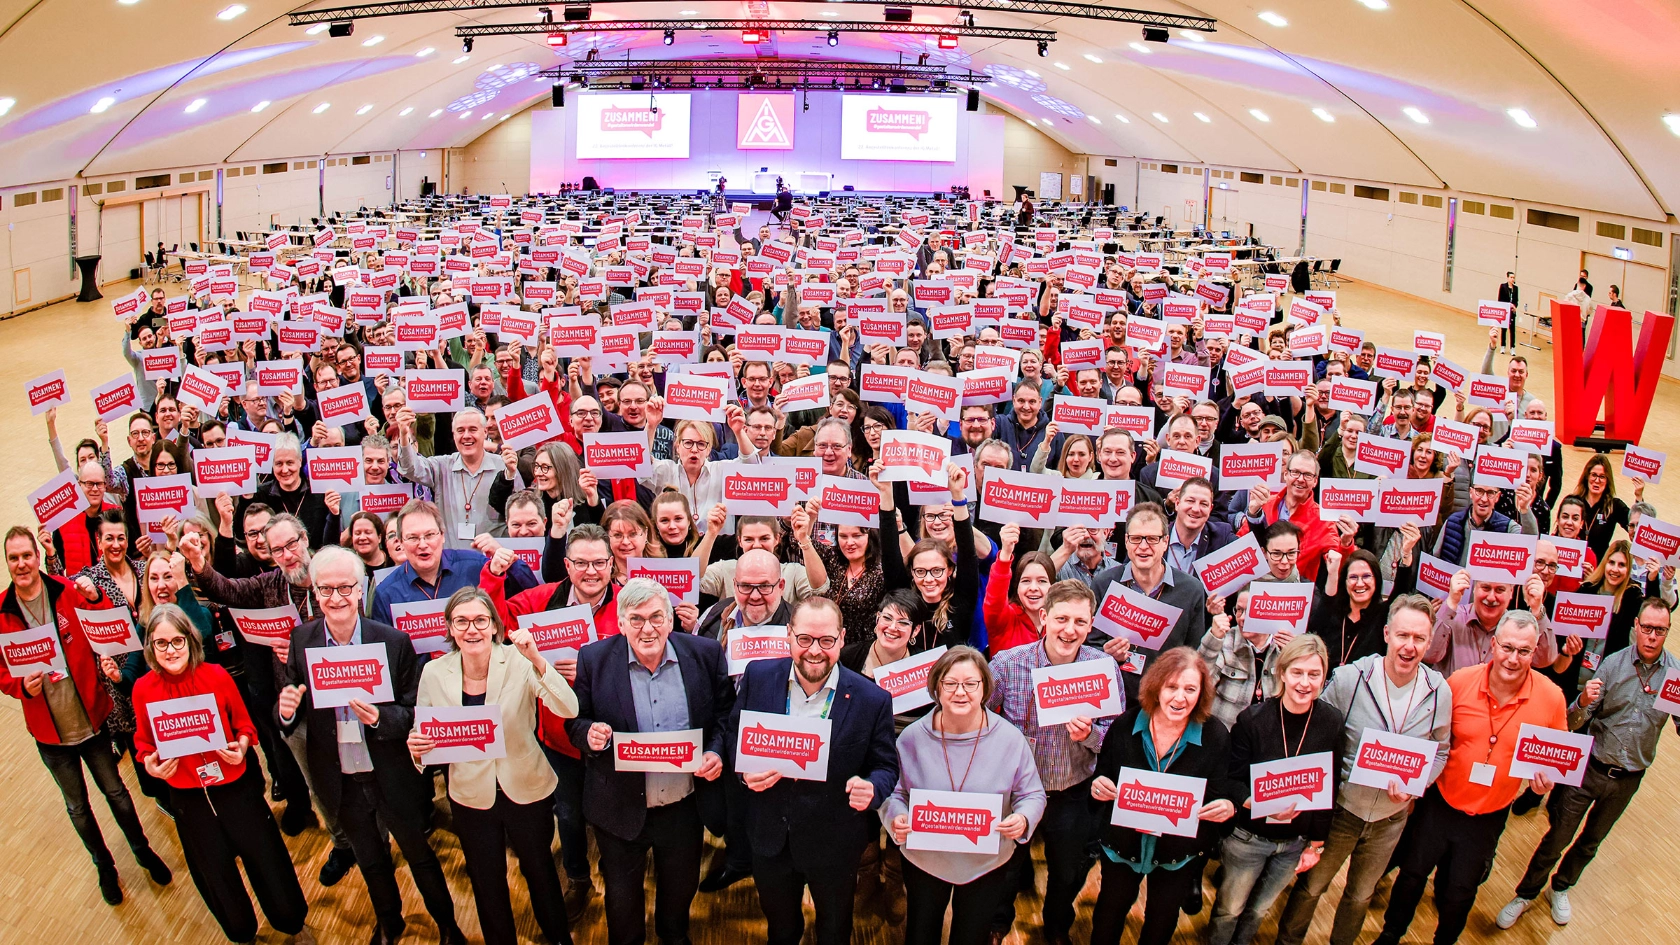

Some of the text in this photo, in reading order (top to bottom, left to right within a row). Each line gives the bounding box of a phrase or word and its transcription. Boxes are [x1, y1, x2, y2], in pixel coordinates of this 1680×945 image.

[869, 113, 925, 125] ZUSAMMEN!
[314, 312, 340, 325] ZUSAMMEN!
[615, 311, 649, 321] ZUSAMMEN!
[935, 314, 969, 325] ZUSAMMEN!
[1071, 308, 1100, 319] ZUSAMMEN!
[502, 319, 532, 330] ZUSAMMEN!
[1236, 315, 1263, 326] ZUSAMMEN!
[400, 327, 434, 335] ZUSAMMEN!
[862, 323, 898, 331] ZUSAMMEN!
[1003, 328, 1032, 336] ZUSAMMEN!
[1129, 325, 1158, 337] ZUSAMMEN!
[281, 331, 313, 339] ZUSAMMEN!
[552, 329, 592, 339] ZUSAMMEN!
[740, 336, 778, 344] ZUSAMMEN!
[1333, 334, 1358, 344] ZUSAMMEN!
[601, 337, 631, 347] SAMMEN!
[787, 340, 821, 349] ZUSAMMEN!
[1064, 349, 1098, 359] ZUSAMMEN!
[146, 357, 174, 366] ZUSAMMEN!
[978, 356, 1012, 366] ZUSAMMEN!
[1379, 356, 1410, 368] ZUSAMMEN!
[261, 371, 295, 380] ZUSAMMEN!
[1167, 373, 1202, 385] ZUSAMMEN!
[1268, 372, 1305, 380] ZUSAMMEN!
[1436, 365, 1462, 382] ZUSAMMEN!
[185, 376, 216, 396] ZUSAMMEN!
[865, 376, 905, 386] ZUSAMMEN!
[30, 381, 61, 400] ZUSAMMEN!
[410, 383, 455, 393] ZUSAMMEN!
[670, 387, 717, 400] ZUSAMMEN!
[910, 383, 952, 400] ZUSAMMEN!
[1334, 387, 1368, 399] ZUSAMMEN!
[1473, 383, 1504, 394] ZUSAMMEN!
[96, 386, 131, 408] ZUSAMMEN!
[323, 395, 360, 411] ZUSAMMEN!
[1057, 407, 1097, 418] ZUSAMMEN!
[501, 408, 546, 432] ZUSAMMEN!
[1110, 416, 1146, 425] ZUSAMMEN!
[1437, 428, 1470, 443] ZUSAMMEN!
[1514, 429, 1546, 439] ZUSAMMEN!
[589, 447, 639, 458] ZUSAMMEN!
[885, 446, 940, 462] ZUSAMMEN!
[1361, 445, 1401, 462] ZUSAMMEN!
[199, 462, 246, 475] ZUSAMMEN!
[311, 461, 354, 472] ZUSAMMEN!
[1163, 461, 1203, 476] ZUSAMMEN!
[1226, 457, 1273, 469] ZUSAMMEN!
[1480, 458, 1519, 471] ZUSAMMEN!
[1627, 455, 1658, 470] ZUSAMMEN!
[728, 480, 783, 492] ZUSAMMEN!
[140, 489, 184, 502] ZUSAMMEN!
[825, 491, 875, 506] ZUSAMMEN!
[989, 485, 1048, 504] ZUSAMMEN!
[1060, 494, 1106, 506] USAMMEN!
[1325, 492, 1368, 502] ZUSAMMEN!
[1385, 495, 1432, 505] ZUSAMMEN!
[35, 486, 73, 516] ZUSAMMEN!
[365, 496, 404, 507] ZUSAMMEN!
[991, 498, 1043, 509] #gestaltenwirdenwandel
[1639, 529, 1678, 549] ZUSAMMEN!
[1474, 547, 1524, 561] ZUSAMMEN!
[1204, 551, 1253, 583] ZUSAMMEN!
[1211, 561, 1252, 587] #gestaltenwirdenwandel
[1423, 567, 1450, 585] ZUSAMM
[1254, 599, 1302, 611] ZUSAMMEN!
[1107, 600, 1163, 630] ZUSAMMEN!
[1558, 606, 1602, 618] ZUSAMMEN!
[242, 619, 290, 631] ZUSAMMEN!
[401, 616, 445, 631] ZUSAMME
[1107, 611, 1155, 634] #gestaltenwirdenwandel
[84, 623, 124, 635] ZUSAMMEN!
[532, 623, 584, 642] USAMMEN!
[6, 641, 51, 659] ZUSAMMEN!
[736, 640, 790, 652] ZUSAMMEN
[315, 663, 376, 680] ZUSAMMEN!
[321, 676, 374, 686] #gestaltenwirdenwandel
[884, 666, 930, 690] ZUSAMME
[1041, 678, 1104, 698] ZUSAMMEN!
[1047, 690, 1101, 705] #gestaltenwirdenwandel
[156, 712, 210, 732] ZUSAMMEN!
[163, 724, 209, 738] #gestaltenwirdenwandel
[424, 723, 489, 738] ZUSAMMEN!
[746, 732, 815, 751] ZUSAMMEN!
[622, 746, 688, 754] ZUSAMMEN!
[750, 746, 809, 757] #gestaltenwirdenwandel
[1522, 741, 1577, 762] ZUSAMMEN!
[1363, 747, 1421, 769] ZUSAMMEN!
[1523, 753, 1571, 766] #gestaltenwirdenwandel
[1364, 759, 1414, 773] #gestaltenwirdenwandel
[1258, 771, 1318, 792] ZUSAMMEN!
[1262, 783, 1315, 798] #gestaltenwirdenwandel
[1123, 787, 1188, 808] ZUSAMMEN!
[1126, 801, 1182, 814] #gestaltenwirdenwandel
[917, 809, 986, 826] ZUSAMMEN!
[920, 823, 981, 831] #gestaltenwirdenwandel
